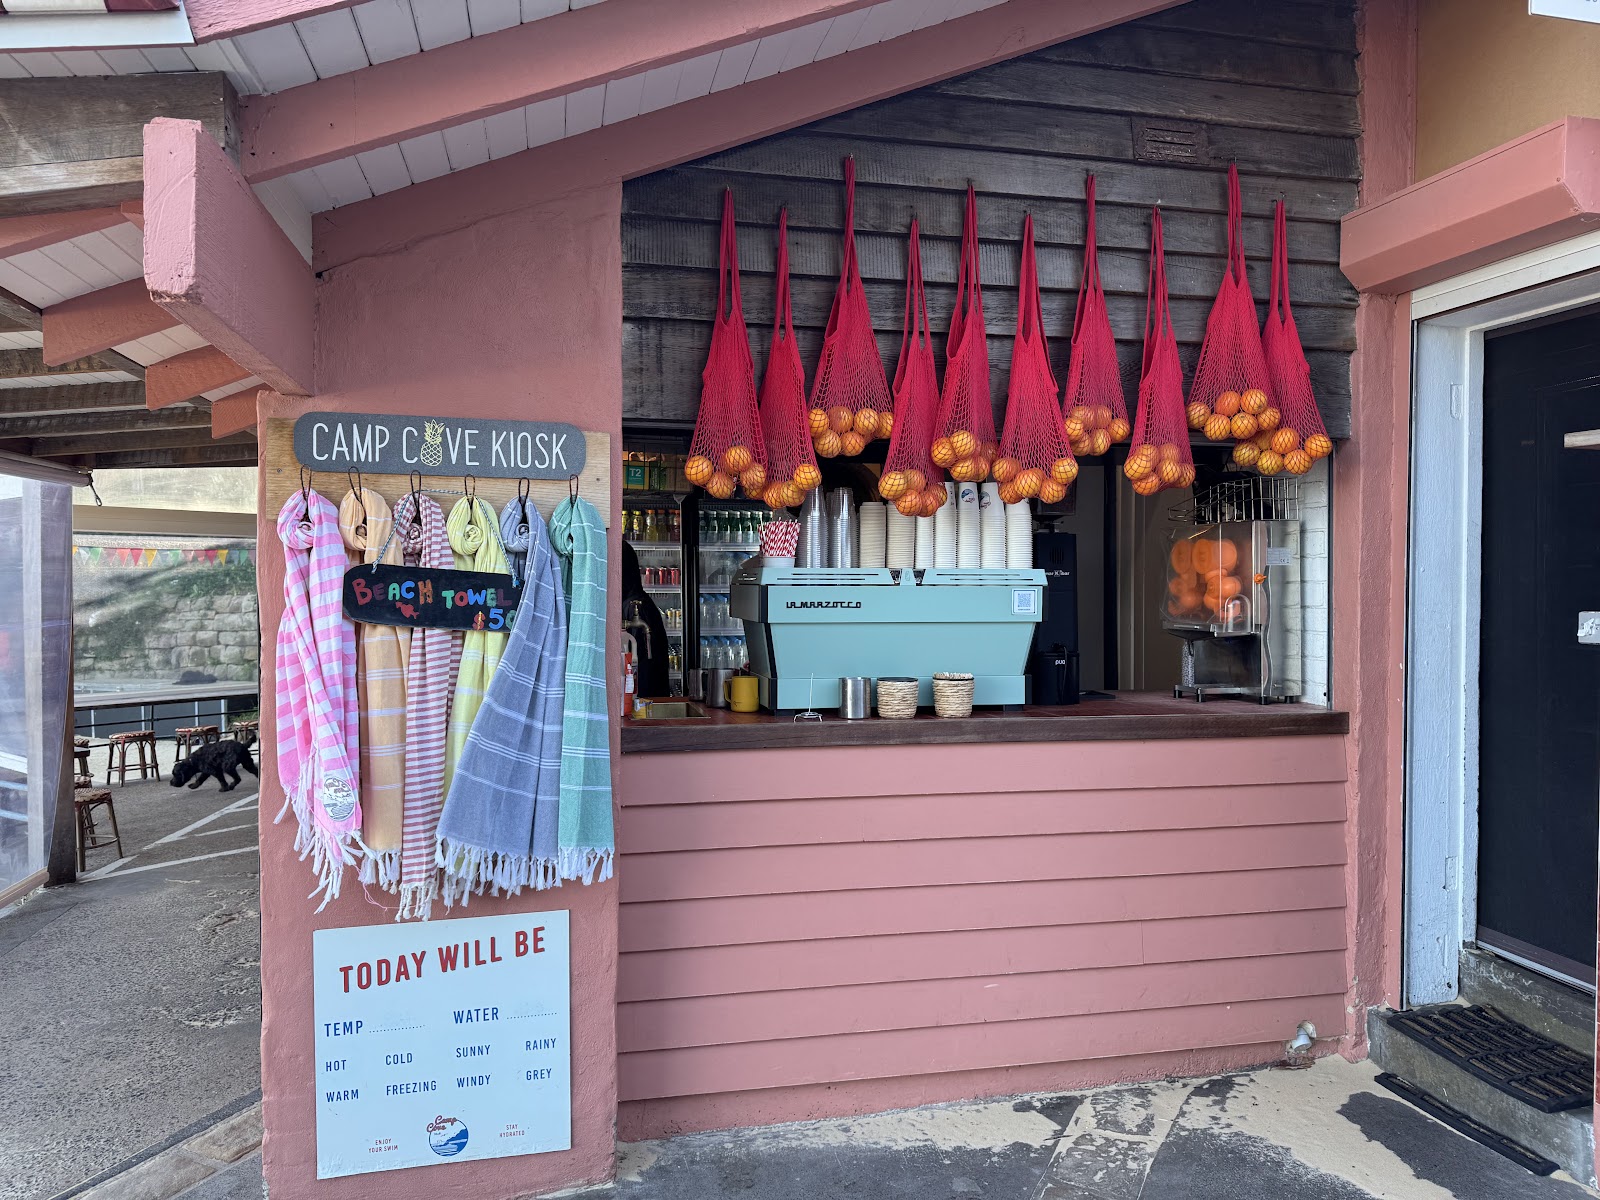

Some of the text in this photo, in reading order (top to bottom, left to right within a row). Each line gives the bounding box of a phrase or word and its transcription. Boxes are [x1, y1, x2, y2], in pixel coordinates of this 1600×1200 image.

[312, 419, 567, 470] CAMP CVE KIOSK
[629, 468, 642, 477] T2
[352, 578, 514, 609] BEACH TOWEL
[786, 601, 862, 609] LA MARZOCCO
[339, 926, 546, 993] TODAY WILL BE
[453, 1007, 499, 1024] WATER
[324, 1020, 364, 1038] TEMP
[456, 1045, 491, 1058] SUNNY
[525, 1038, 557, 1051] RAINY
[325, 1059, 347, 1072] HOT
[385, 1052, 413, 1066] COLD
[456, 1074, 491, 1088] WINDY
[526, 1068, 552, 1081] GREY
[386, 1080, 437, 1096] FREEZING
[326, 1088, 359, 1103] WARM
[499, 1130, 525, 1138] HYDRATED
[384, 1144, 398, 1152] SWIM
